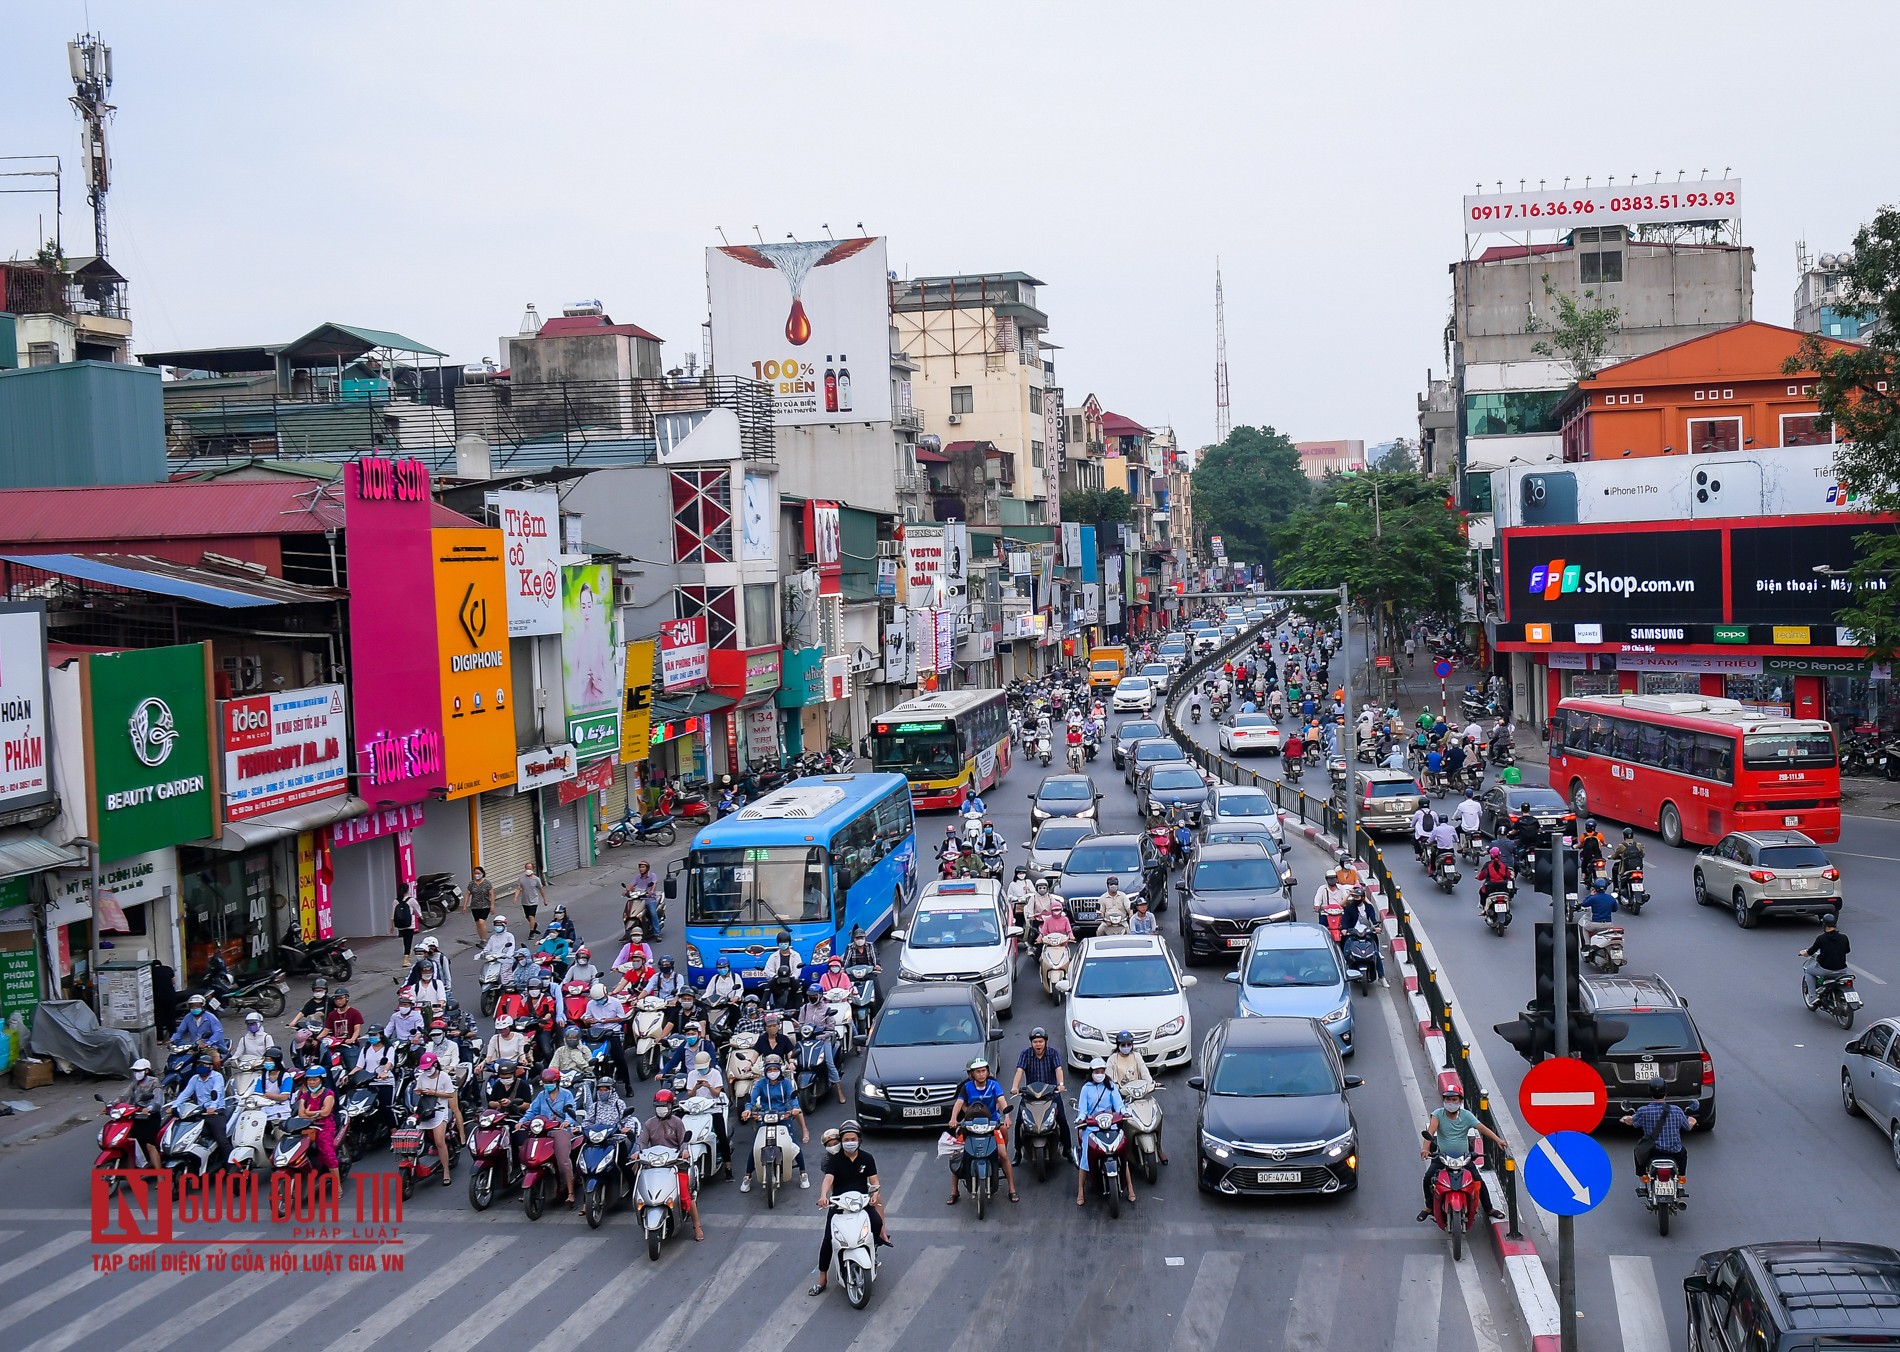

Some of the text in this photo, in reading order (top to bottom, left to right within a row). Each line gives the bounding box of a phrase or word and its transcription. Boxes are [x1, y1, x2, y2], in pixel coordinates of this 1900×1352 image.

[1471, 200, 1595, 220] 0917.16.36.96
[1610, 191, 1736, 212] 0383.51.93.93
[751, 359, 815, 380] 100%
[362, 447, 392, 500] NÓN
[1610, 484, 1658, 496] iPhone 11 Pro
[505, 508, 547, 543] Tiệm
[907, 529, 944, 538] BENSON
[509, 542, 525, 566] cô
[910, 547, 942, 558] VESTON
[519, 568, 556, 603] Kẹo
[1756, 578, 1782, 594] Điện
[1786, 578, 1818, 594] thoại
[673, 620, 696, 646] deli
[1630, 628, 1684, 640] SAMSUNG
[1776, 630, 1807, 640] realme
[452, 650, 503, 673] DIGIPHONE
[1636, 658, 1644, 666] 3
[1647, 657, 1678, 666] NĂM
[1715, 659, 1757, 669] TRIỆU
[1770, 660, 1865, 671] OPPO Reno2 F
[1, 695, 31, 722] HOÀN
[232, 705, 269, 732] idea
[750, 711, 774, 722] 134
[5, 724, 42, 773] PHẨM
[374, 730, 405, 785] NÓN
[106, 775, 204, 812] BEAUTY GARDEN
[82, 874, 106, 891] PHM
[249, 896, 267, 923] A0
[251, 932, 270, 958] A4
[1640, 1063, 1654, 1072] 29A
[1258, 1172, 1301, 1183] 30F-474.31
